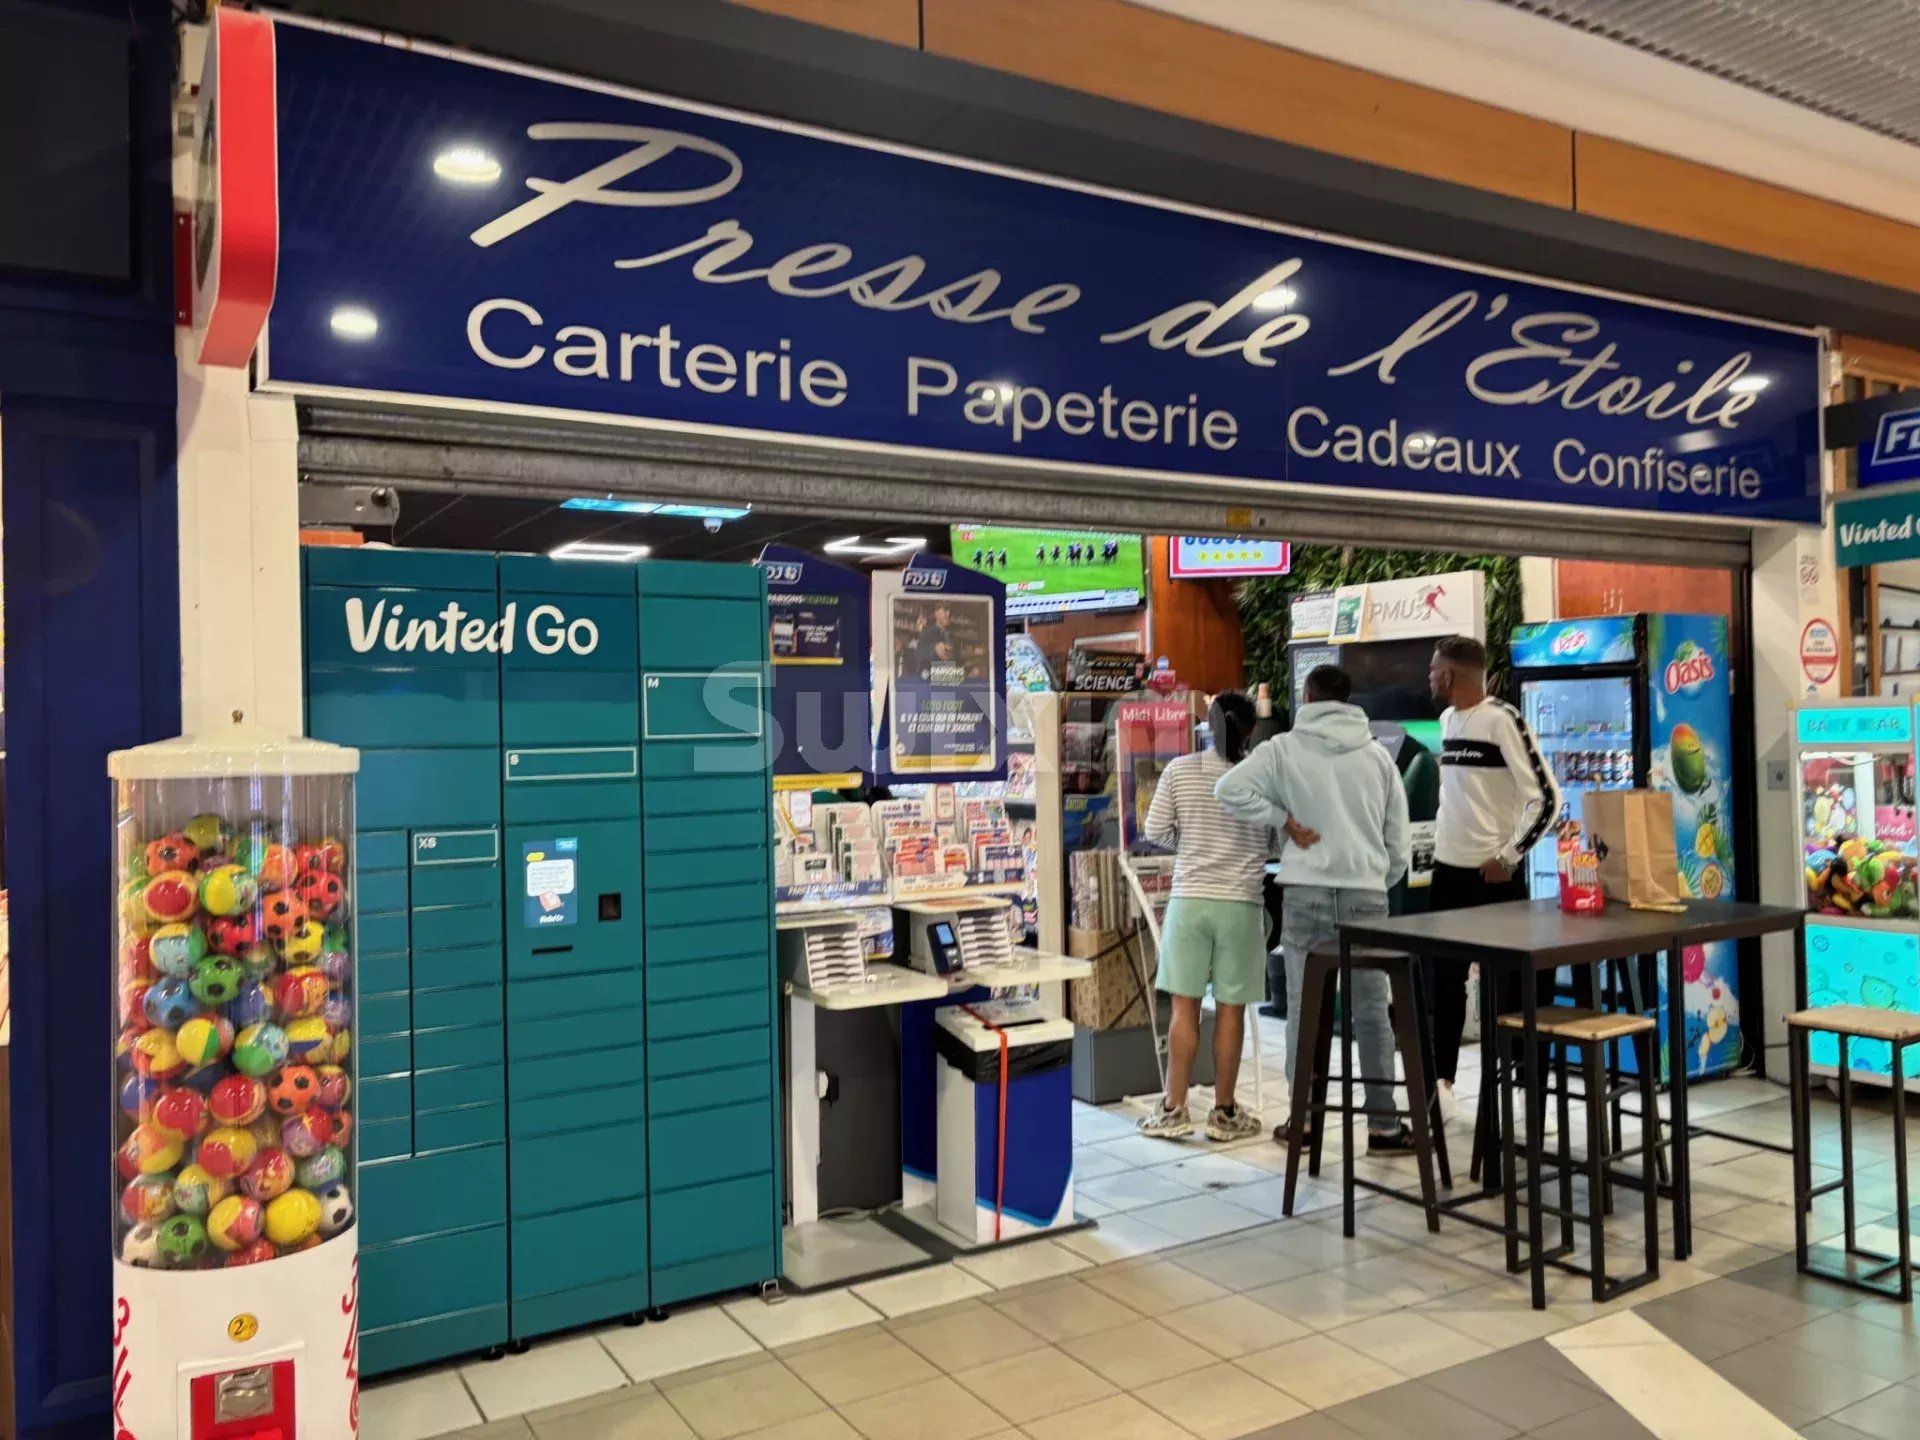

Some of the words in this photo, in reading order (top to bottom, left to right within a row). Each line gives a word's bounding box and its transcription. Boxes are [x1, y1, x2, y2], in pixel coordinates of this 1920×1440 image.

[470, 121, 1080, 333] Presse
[1100, 257, 1310, 367] de
[1327, 289, 1757, 429] l'Etoile
[466, 298, 848, 408] Carterie
[907, 356, 1239, 451] Papeterie
[1287, 406, 1521, 479] Cadeaux
[1552, 437, 1761, 500] Confiserie
[1839, 514, 1914, 548] Vinted
[905, 571, 929, 586] FDJ
[1369, 600, 1417, 622] PMU
[345, 597, 517, 654] Vinted
[526, 604, 600, 656] Go
[1665, 649, 1715, 694] Oasis
[647, 678, 659, 688] M
[1074, 675, 1135, 691] SCIENCE
[1122, 707, 1151, 721] Midi
[1154, 707, 1188, 721] Libre
[510, 755, 519, 766] S
[418, 837, 437, 849] XS
